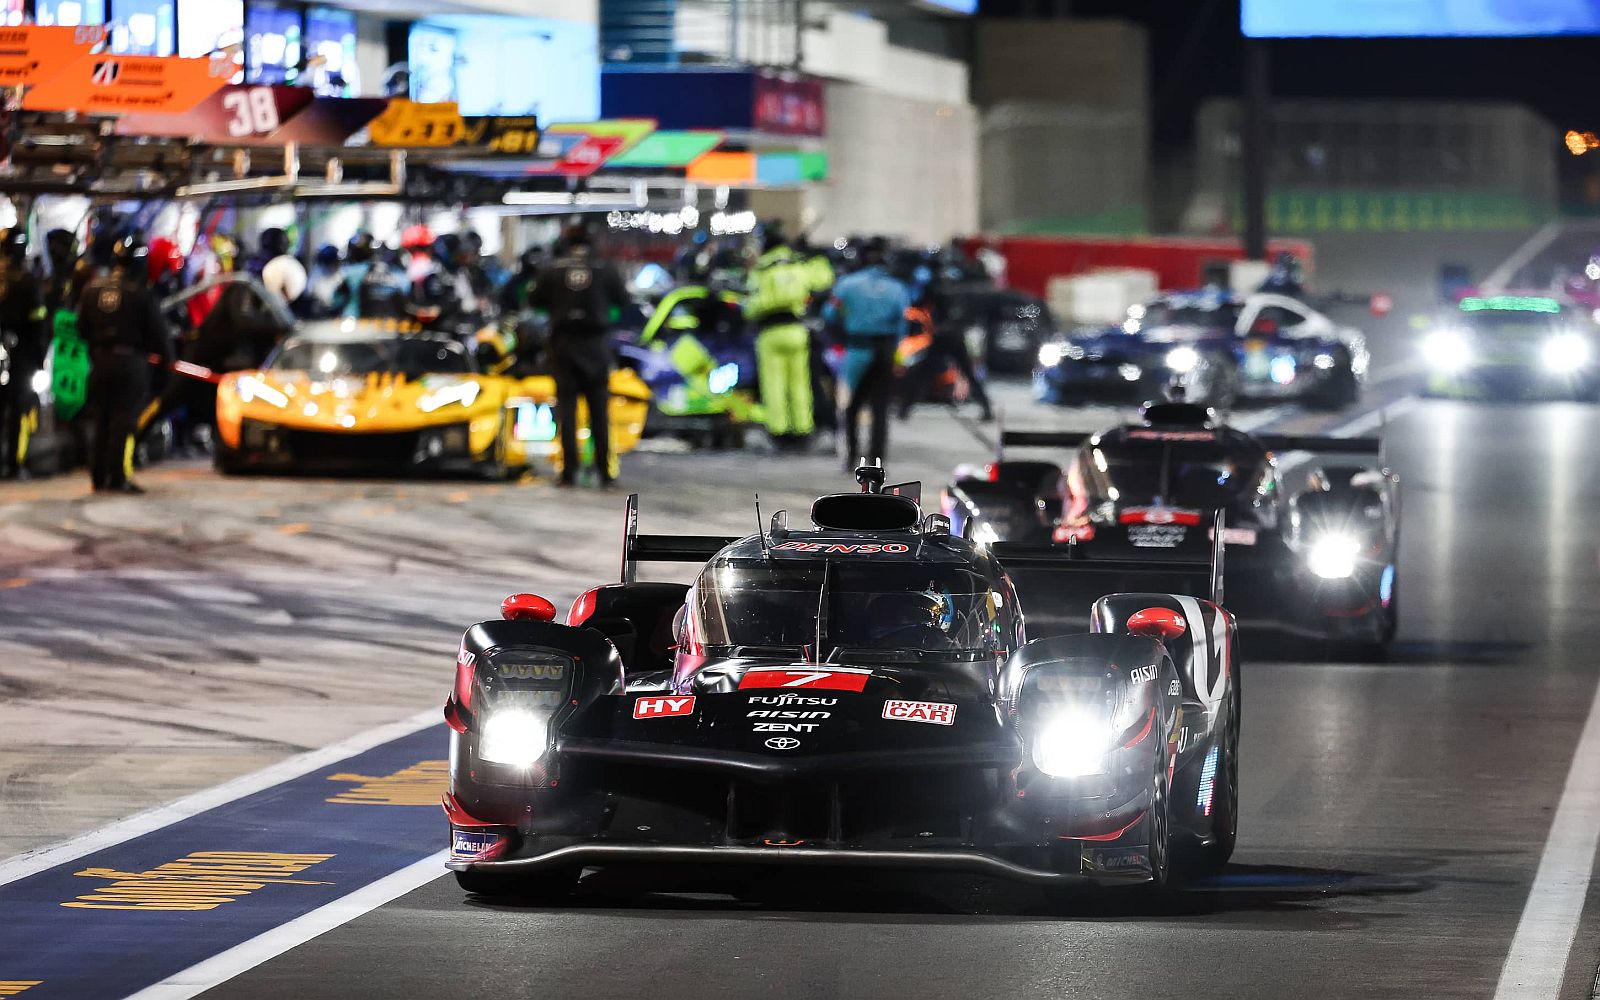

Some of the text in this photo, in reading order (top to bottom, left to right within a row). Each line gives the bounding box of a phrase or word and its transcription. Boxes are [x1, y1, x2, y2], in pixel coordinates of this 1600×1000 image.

[223, 86, 279, 137] 38
[770, 541, 909, 553] DENSO
[781, 671, 833, 687] 7
[1130, 664, 1158, 685] AISIN
[638, 698, 691, 715] HY
[748, 694, 838, 707] FUJITSU
[891, 701, 950, 711] HYPER
[746, 710, 832, 719] AISIN
[889, 707, 948, 722] CAR
[752, 722, 820, 733] ZENT
